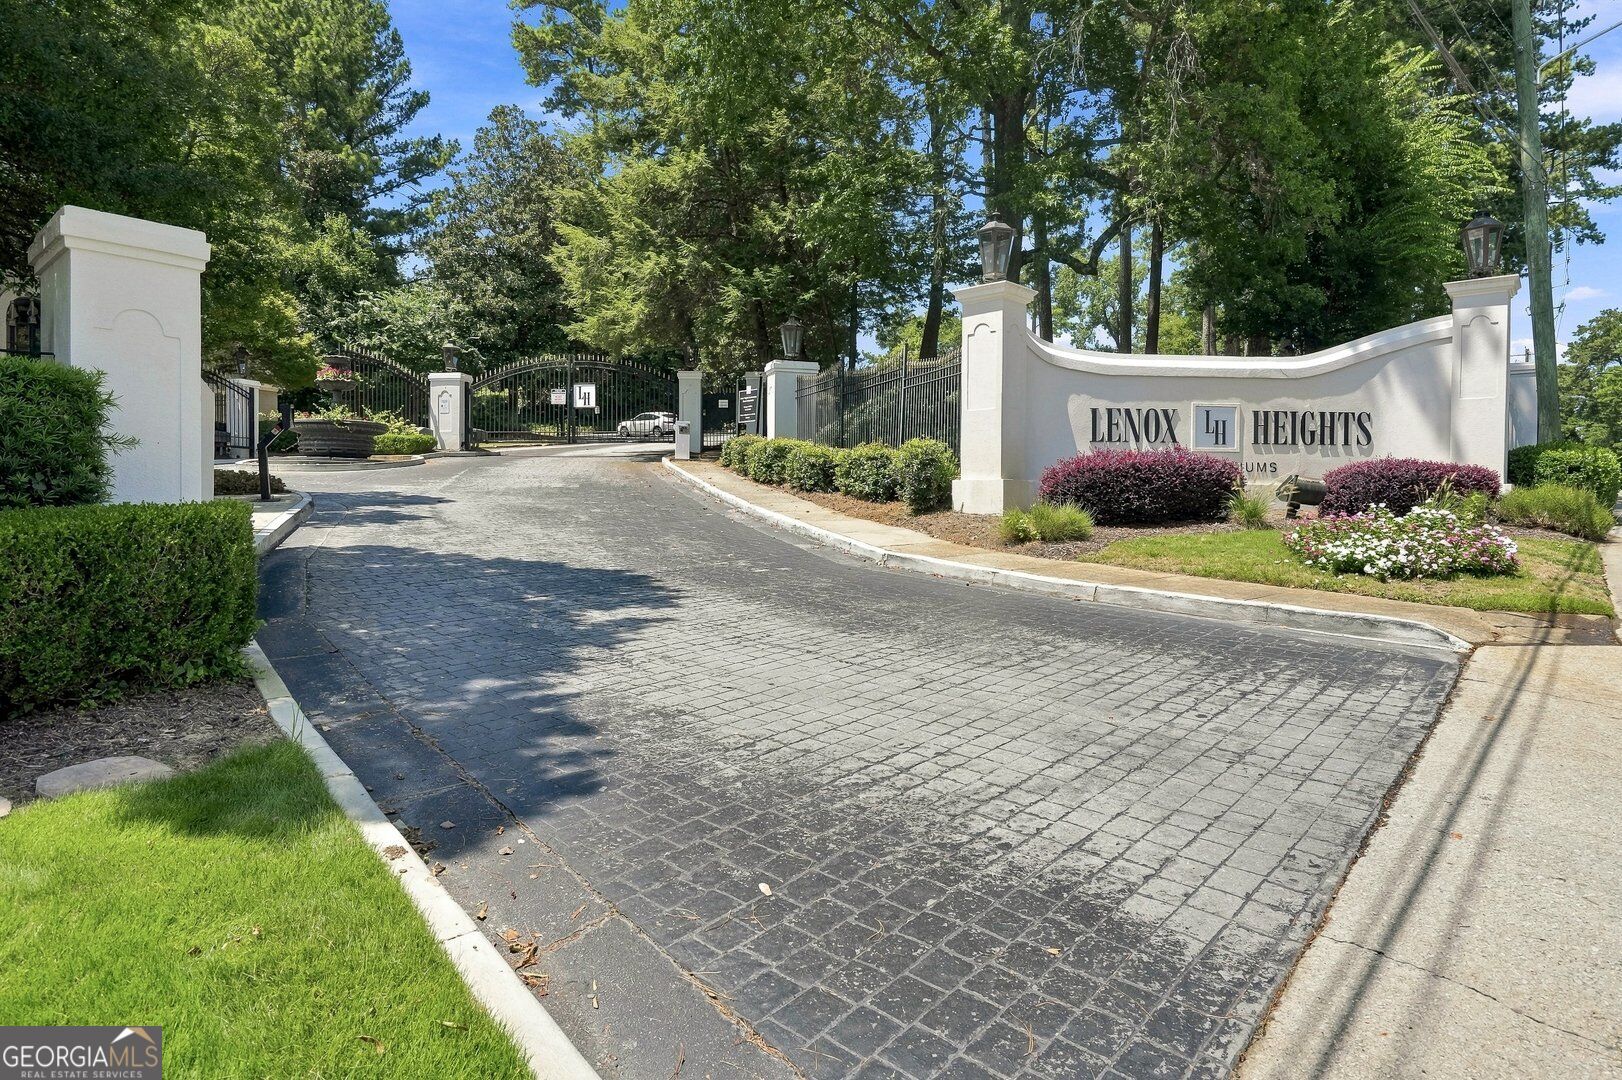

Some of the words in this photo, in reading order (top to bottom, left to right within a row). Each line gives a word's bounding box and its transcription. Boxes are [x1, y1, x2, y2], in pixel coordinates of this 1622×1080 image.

[578, 386, 590, 406] LH
[1089, 407, 1179, 444] LENOX
[1251, 410, 1373, 446] HEIGHTS
[1204, 409, 1228, 446] LH
